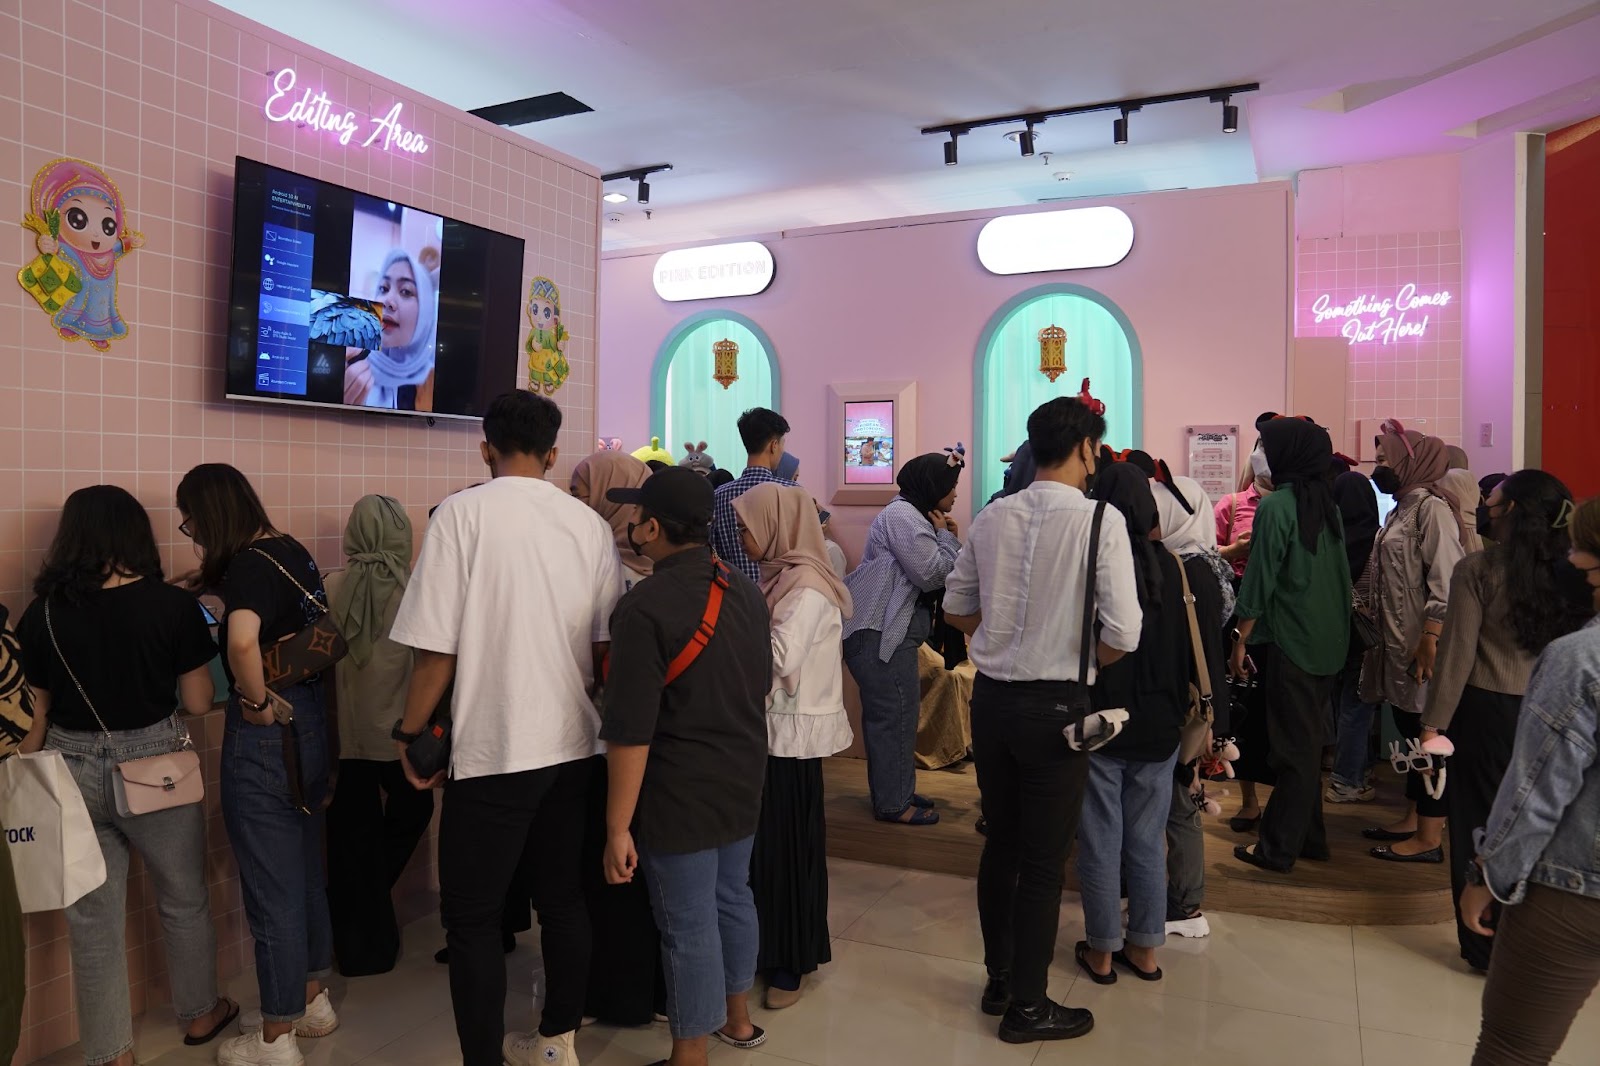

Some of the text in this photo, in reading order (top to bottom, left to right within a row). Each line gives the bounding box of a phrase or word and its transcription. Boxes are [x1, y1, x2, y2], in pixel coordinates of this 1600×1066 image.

[264, 68, 429, 154] Editing Area
[271, 188, 288, 199] Android
[271, 195, 306, 209] ENTERTAINMENT
[659, 260, 766, 284] PINK EDITION
[1312, 283, 1452, 324] Something Comes
[1375, 312, 1430, 346] Here!
